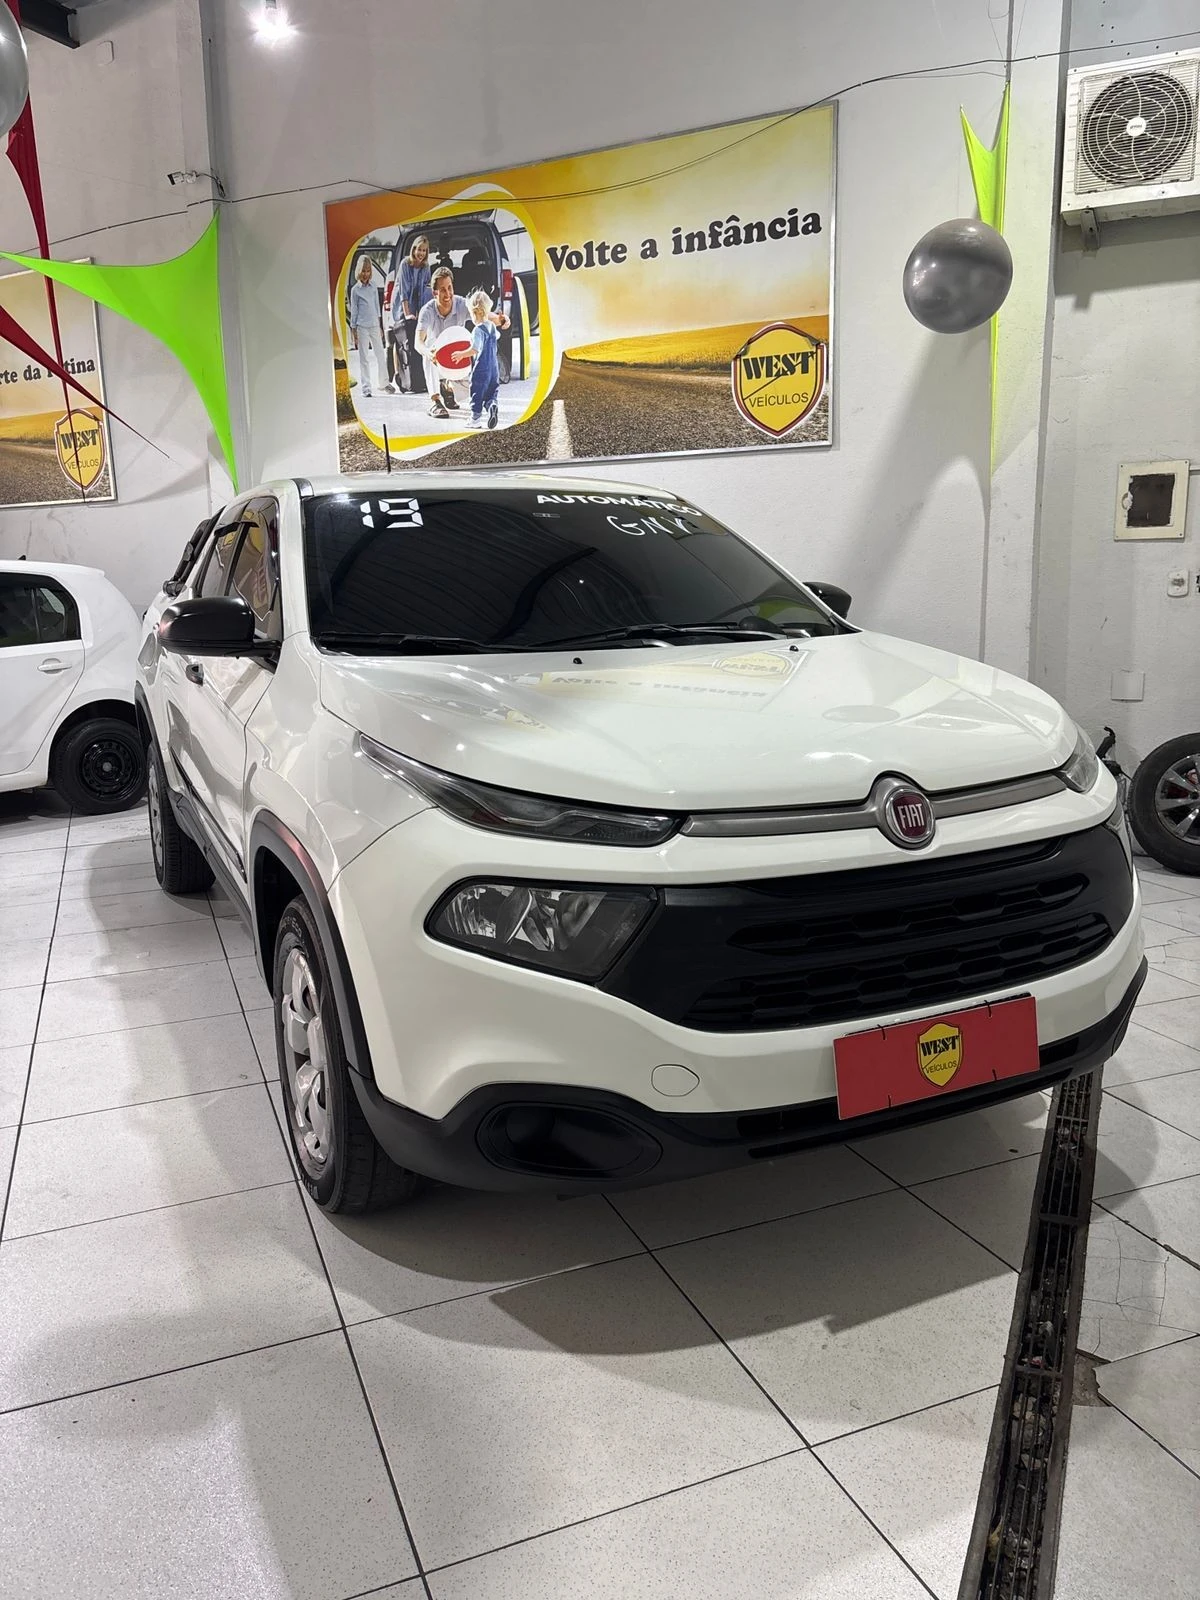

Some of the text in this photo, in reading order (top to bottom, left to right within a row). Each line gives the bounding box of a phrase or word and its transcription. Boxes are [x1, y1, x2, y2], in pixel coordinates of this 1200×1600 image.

[546, 207, 822, 273] Volte a infância
[23, 364, 42, 381] da
[47, 357, 96, 378] tina
[742, 350, 816, 380] WEST
[748, 391, 809, 408] VEÍCULOS
[60, 428, 99, 449] WEST
[359, 497, 424, 529] 19
[536, 493, 703, 517] AUTOMÁTICO
[897, 803, 925, 830] FIAT
[920, 1034, 960, 1057] WEST
[925, 1060, 958, 1074] VEÍCULOS
